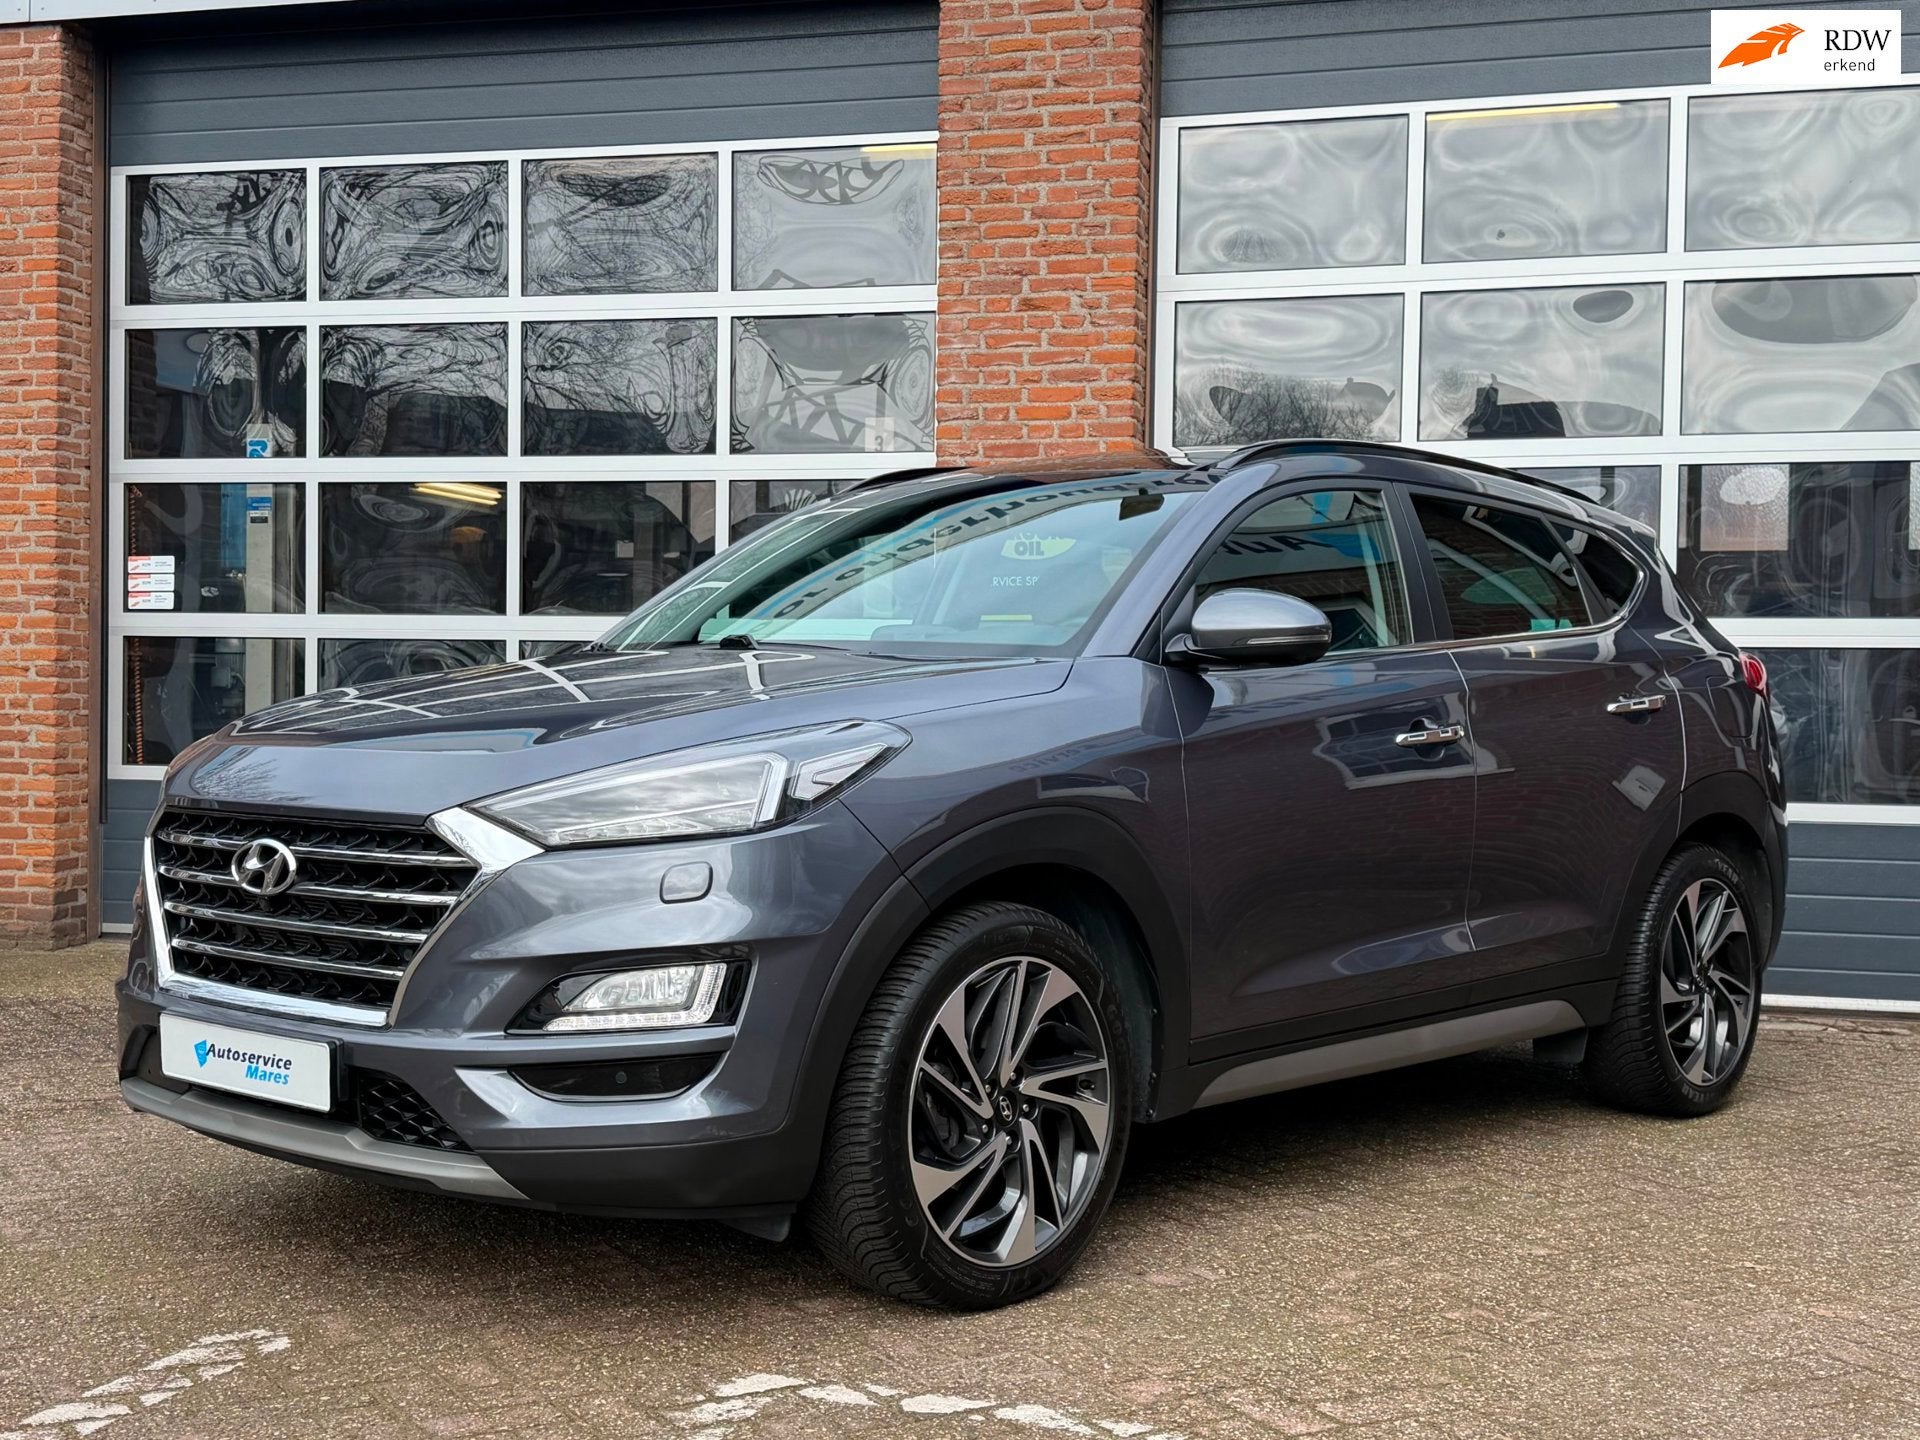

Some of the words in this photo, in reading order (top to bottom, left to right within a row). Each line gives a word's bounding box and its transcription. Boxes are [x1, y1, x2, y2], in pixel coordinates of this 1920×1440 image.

[1014, 540, 1045, 557] OIL
[990, 576, 1023, 587] RVICE
[1025, 576, 1040, 586] SP
[206, 1042, 293, 1071] Autoservice
[245, 1064, 290, 1086] Mares
